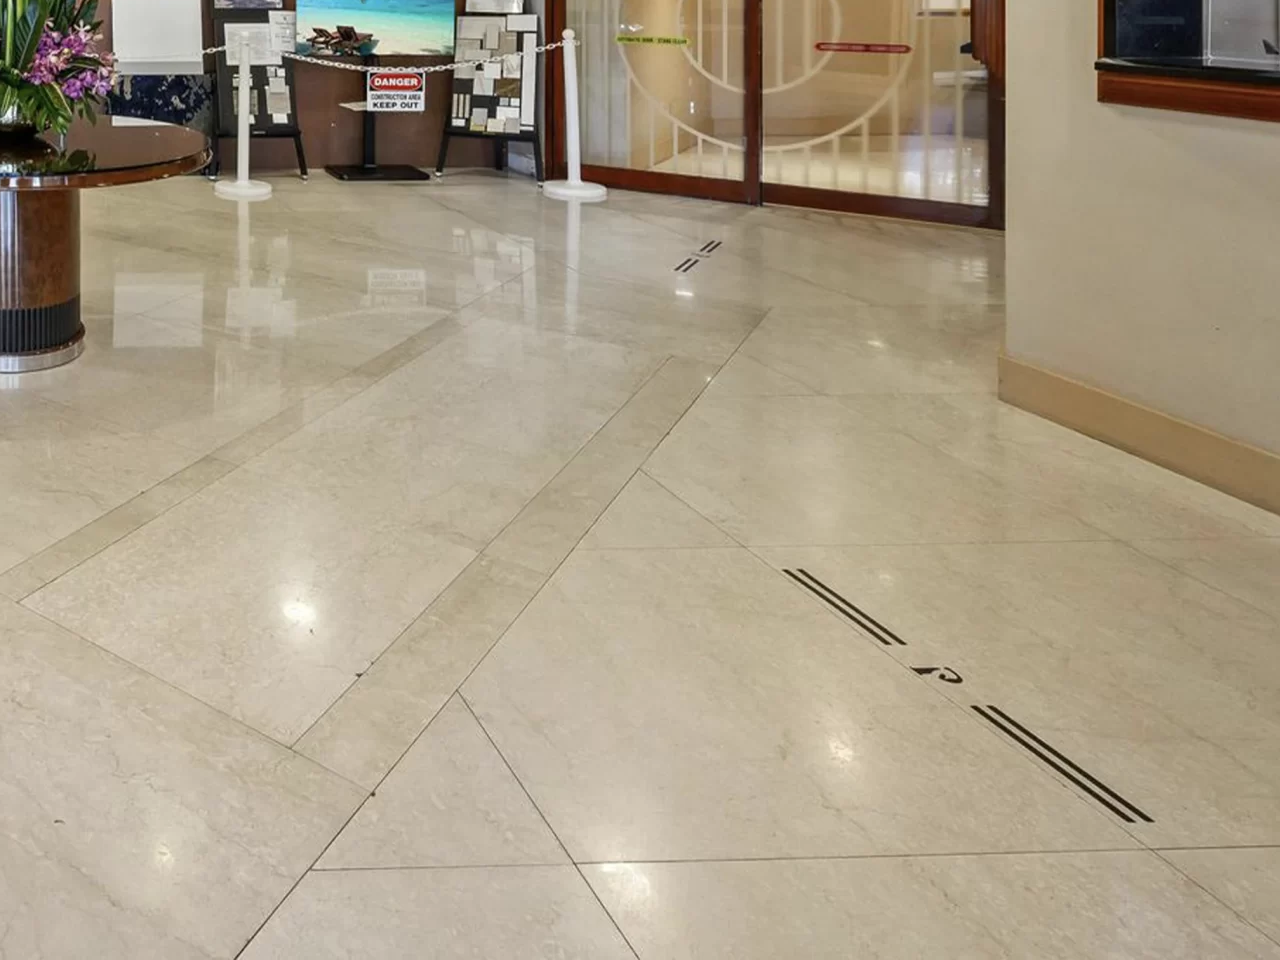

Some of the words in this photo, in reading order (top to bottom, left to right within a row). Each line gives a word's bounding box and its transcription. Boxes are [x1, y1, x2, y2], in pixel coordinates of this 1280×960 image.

[374, 77, 418, 86] DANGER
[372, 101, 397, 109] KEEP
[400, 101, 419, 109] OUT
